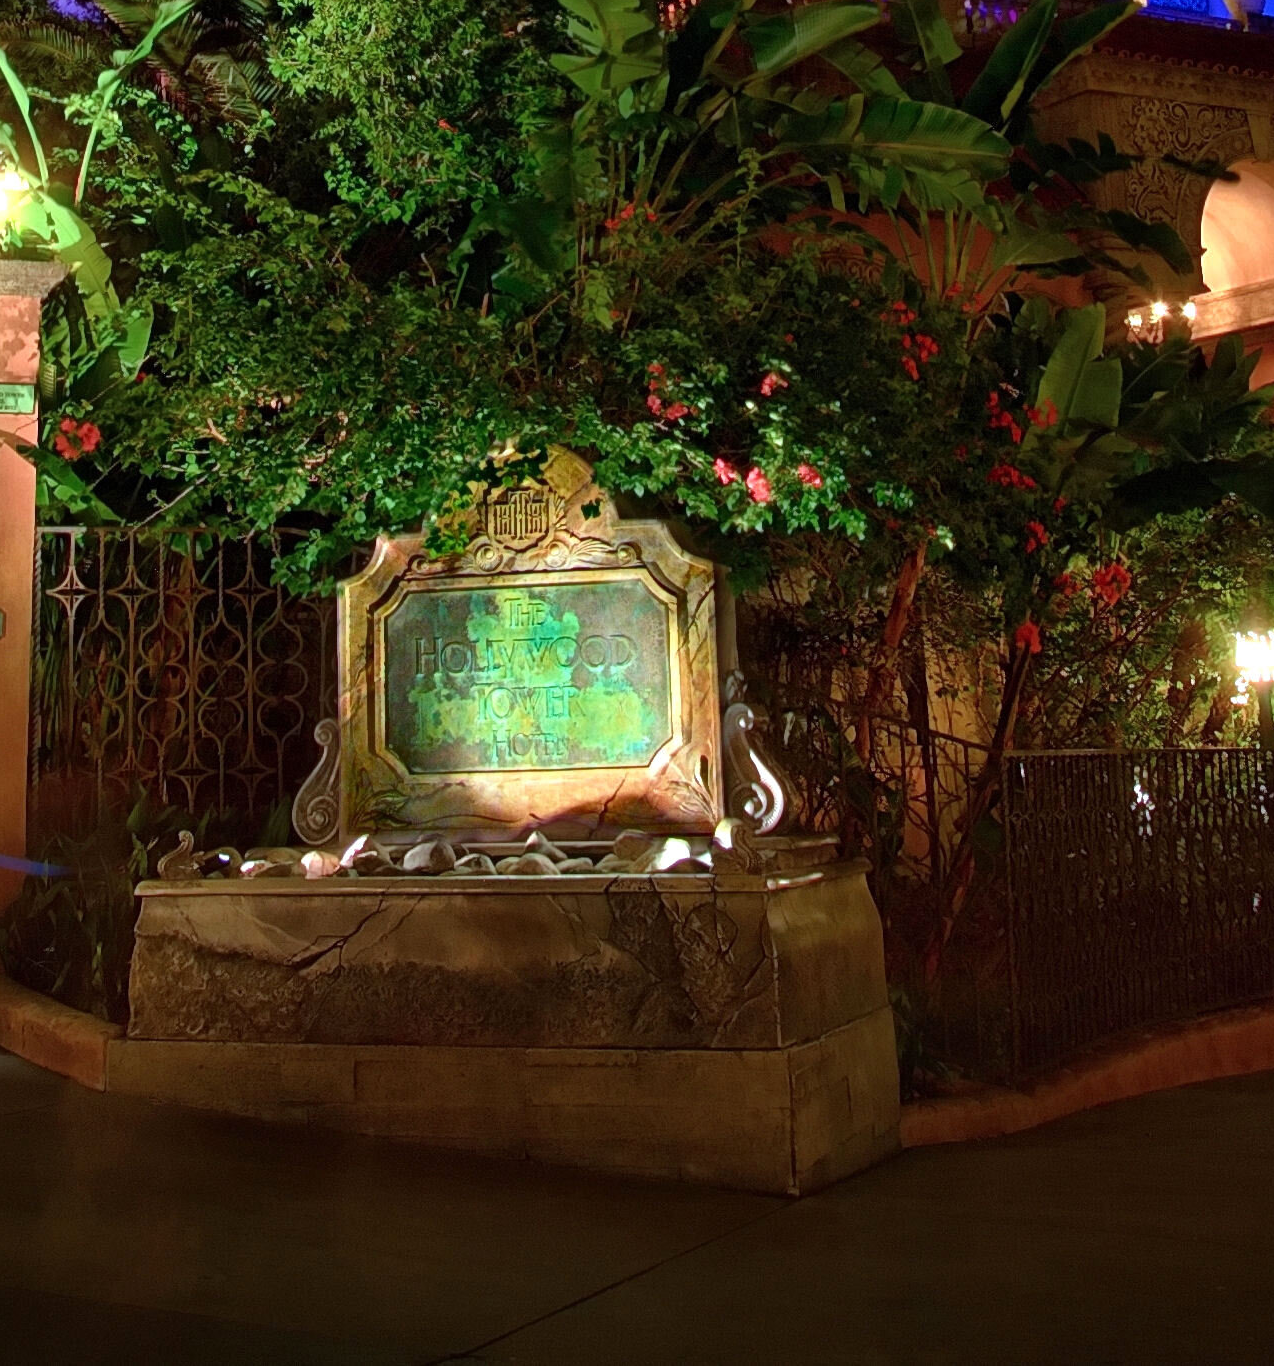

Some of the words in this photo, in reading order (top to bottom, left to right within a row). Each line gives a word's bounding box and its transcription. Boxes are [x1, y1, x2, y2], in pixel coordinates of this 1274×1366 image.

[504, 598, 550, 628] THE
[414, 633, 638, 680] HOLLYWOOD
[470, 682, 586, 723] TOWER
[492, 729, 568, 760] HOTEL
